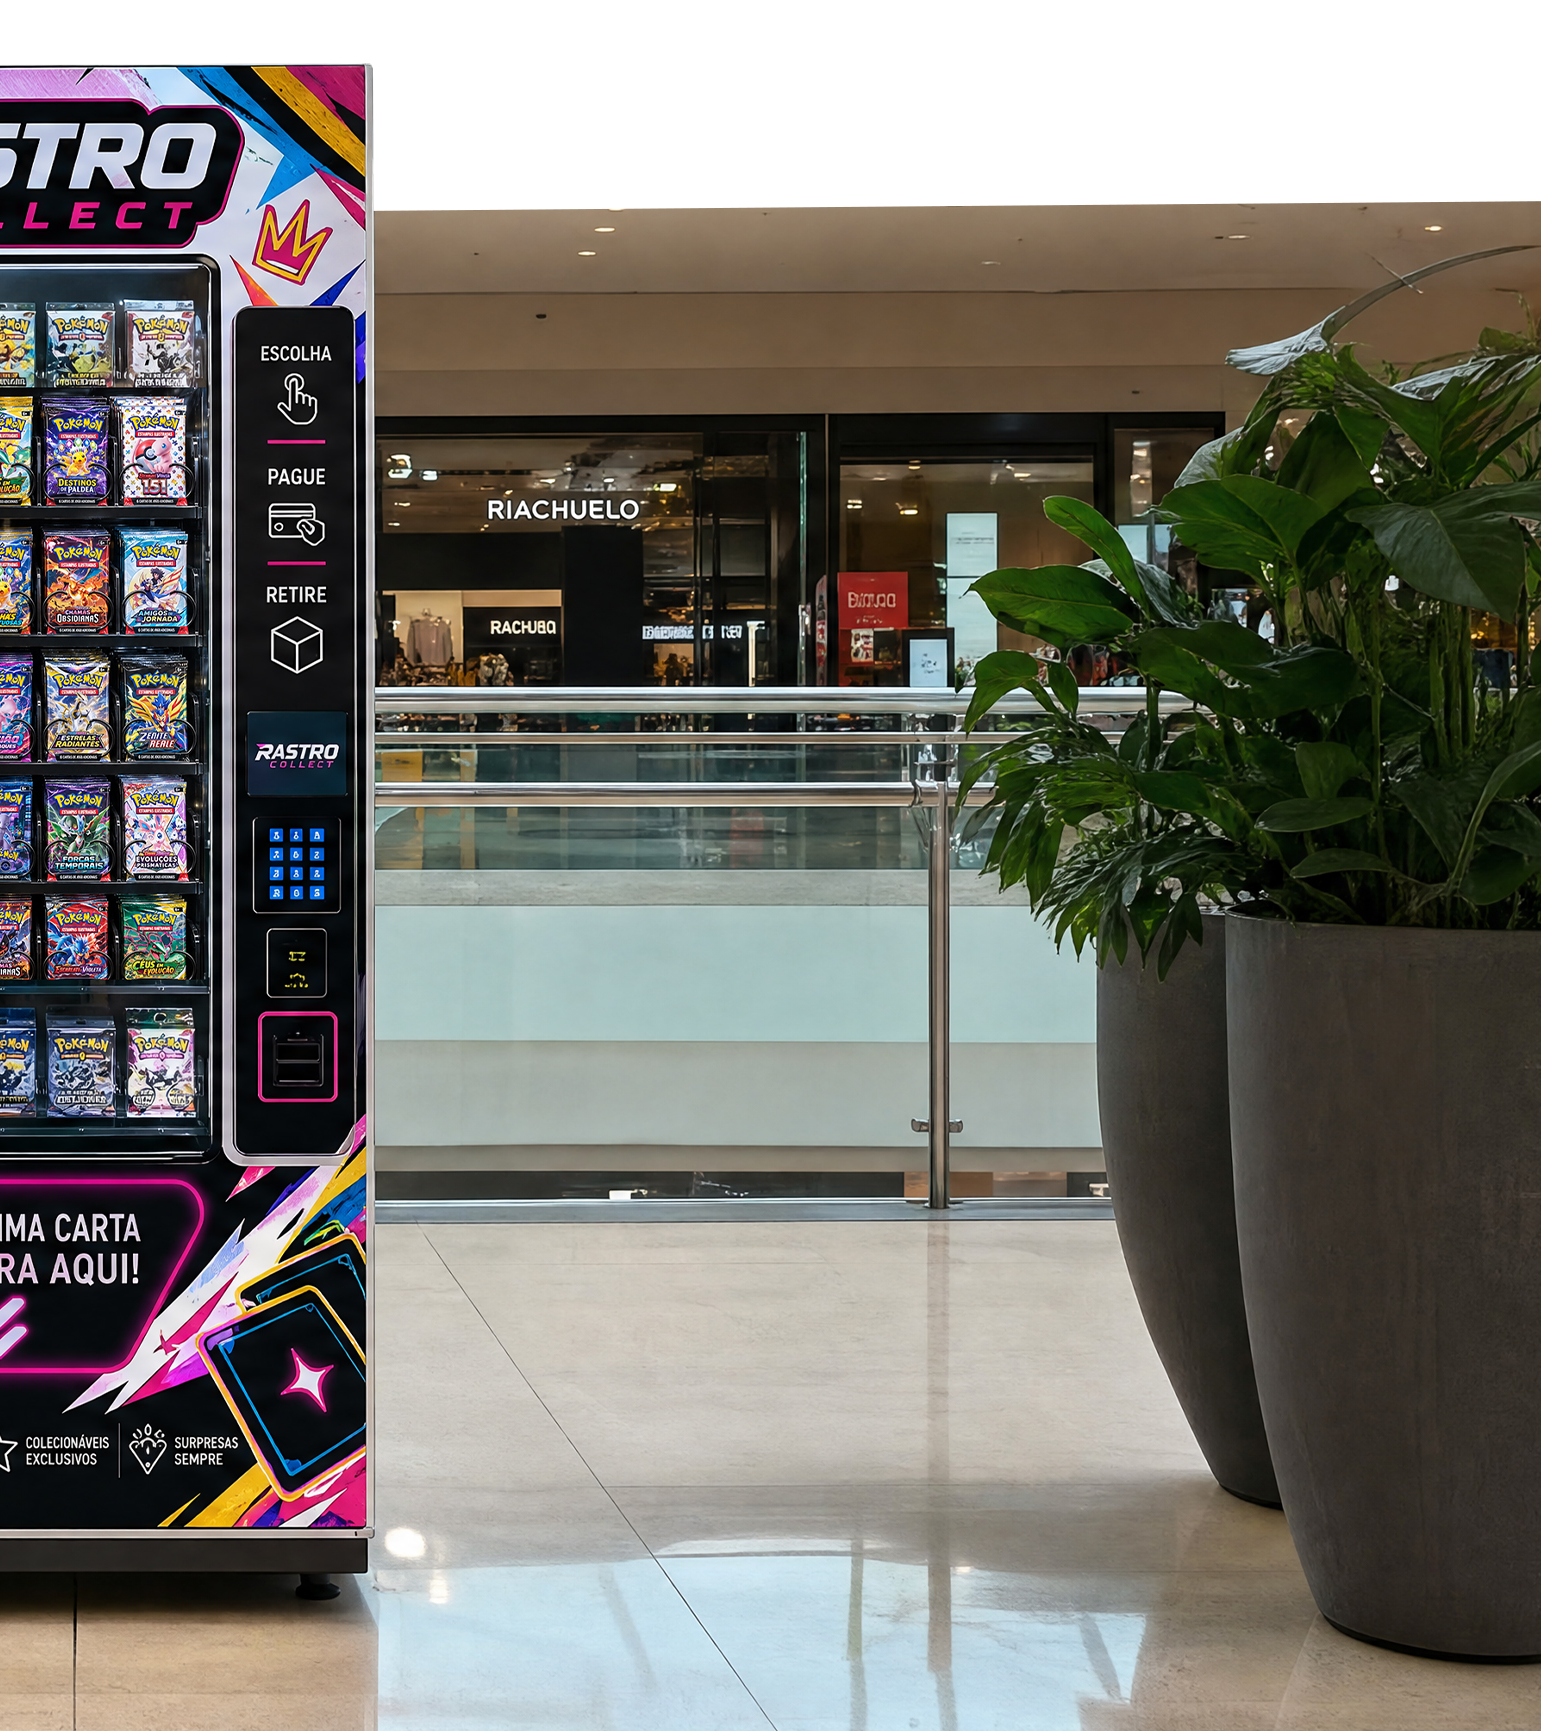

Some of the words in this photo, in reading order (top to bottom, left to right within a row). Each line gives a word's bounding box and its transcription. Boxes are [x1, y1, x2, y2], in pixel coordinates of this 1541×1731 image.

[261, 345, 331, 361] ESCOLHA
[52, 415, 103, 432] Pokémon
[129, 414, 180, 431] Pokémon
[267, 468, 326, 485] PAGUE
[142, 479, 167, 494] 151
[488, 500, 640, 519] RIACHUELO
[54, 544, 103, 561] Pokémon
[132, 543, 181, 561] Pokémon
[266, 586, 327, 603] RETIRE
[53, 672, 103, 688] Pokémon
[130, 670, 180, 688] Pokémon
[255, 744, 339, 761] RASTRO
[54, 791, 103, 808] Pokémon
[130, 790, 179, 807] Pokémon
[55, 909, 102, 926] Pokémon
[132, 911, 177, 926] Pokémon
[55, 1213, 141, 1242] CARTA
[49, 1253, 139, 1286] AQUI!
[26, 1434, 109, 1449] COLECIONÁVEIS
[175, 1437, 238, 1449] SURPRESAS
[26, 1453, 97, 1465] EXCLUSIVOS
[175, 1453, 223, 1465] SEMPRE
